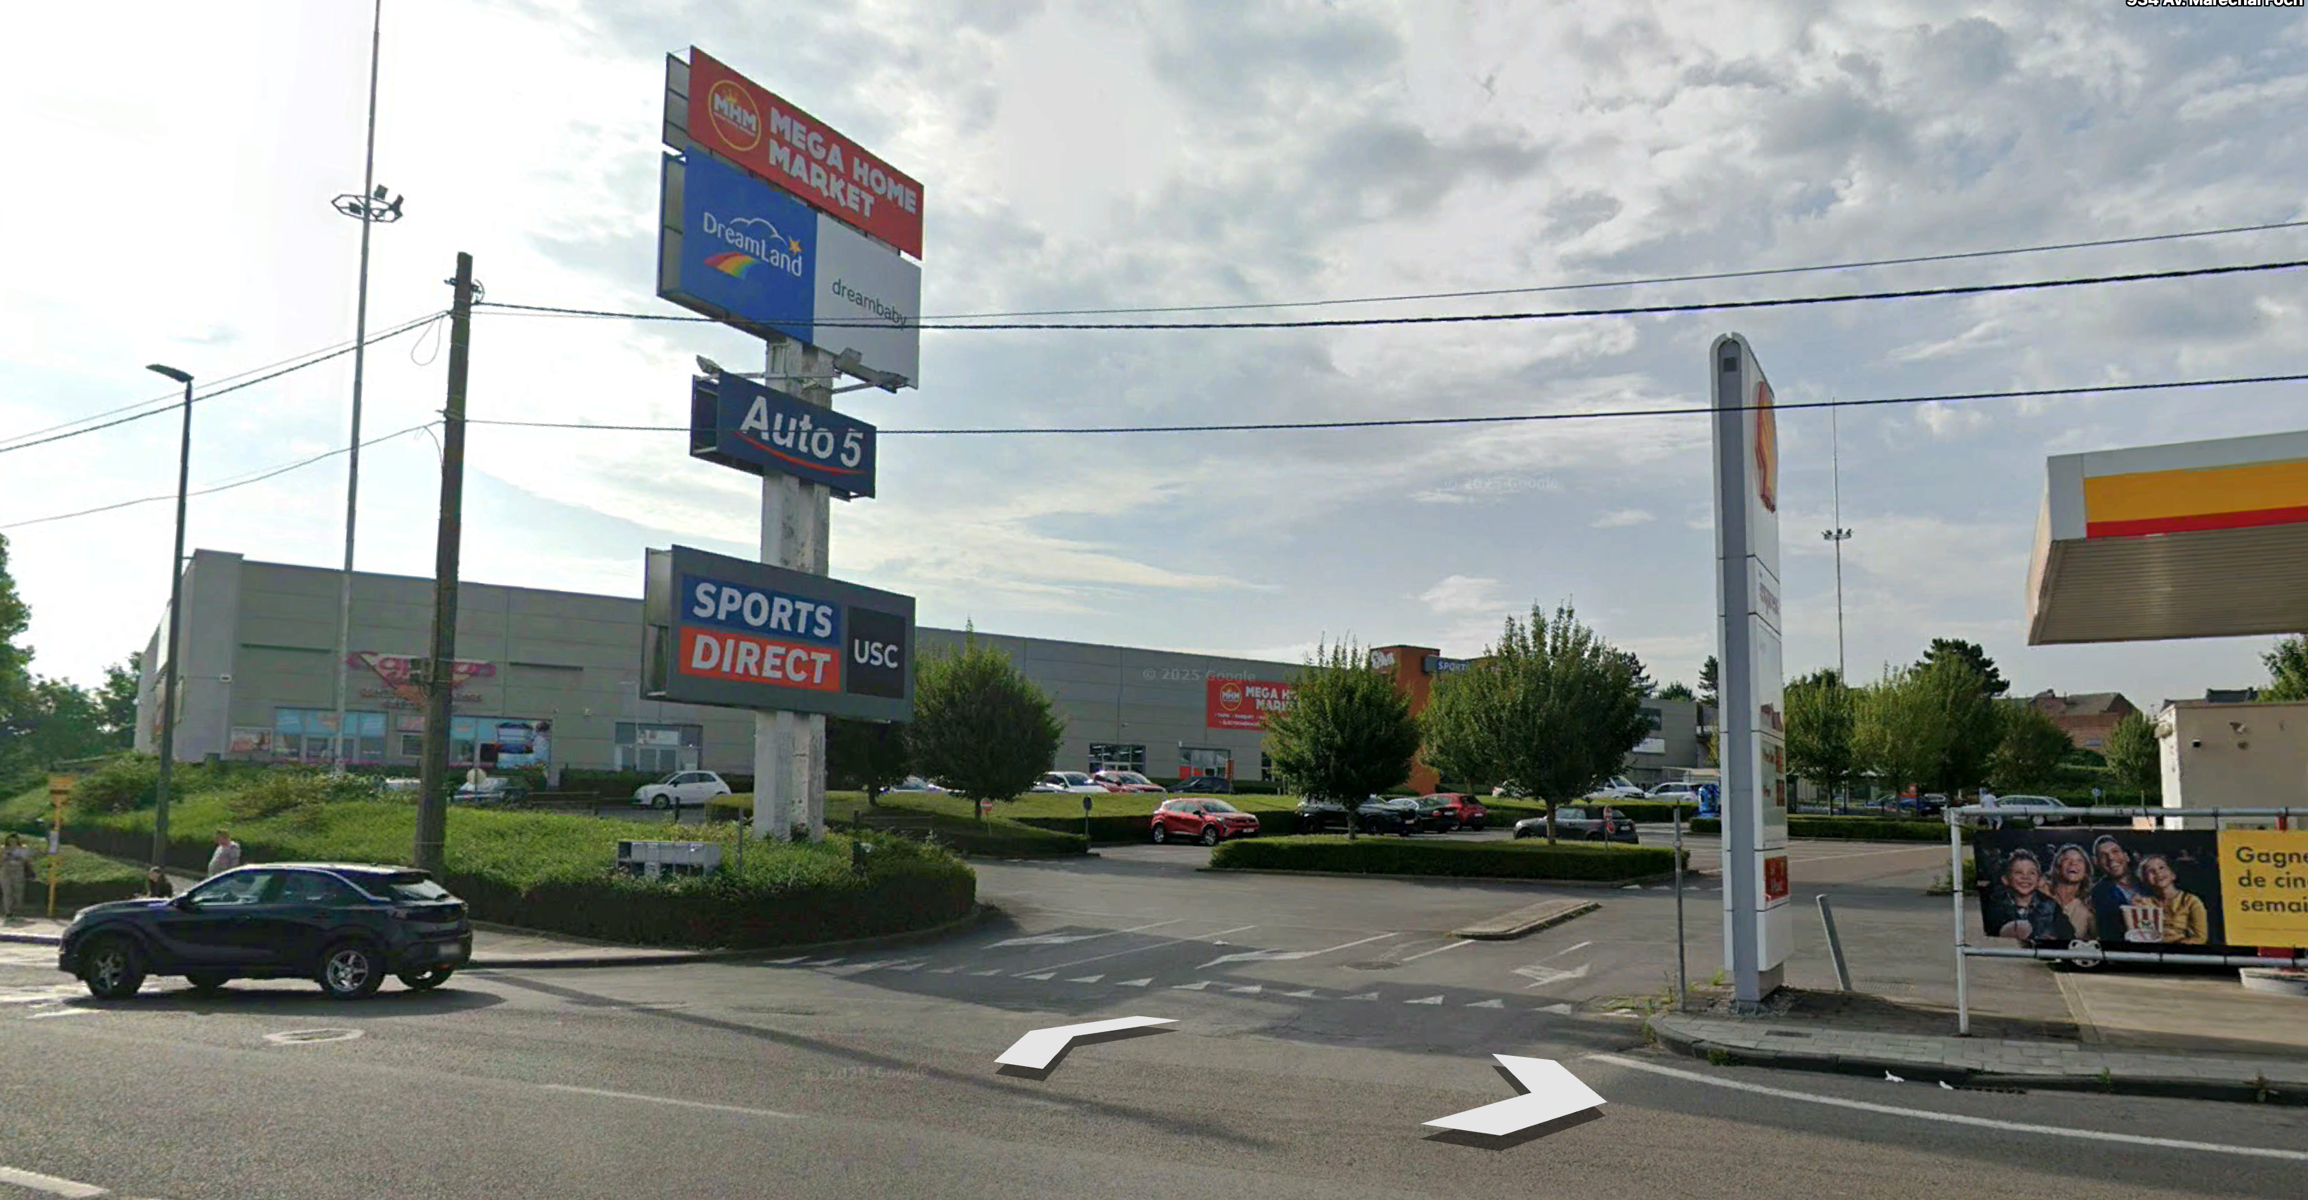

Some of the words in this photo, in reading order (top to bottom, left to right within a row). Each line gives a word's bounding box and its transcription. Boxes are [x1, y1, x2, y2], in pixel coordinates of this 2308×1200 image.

[713, 92, 757, 132] MHM
[769, 138, 875, 218] MARKET
[770, 107, 845, 174] MEGA
[853, 156, 917, 215] HOME
[703, 211, 803, 278] DreamLand
[832, 278, 907, 331] dreambaby
[740, 395, 834, 459] Auto
[840, 428, 864, 468] 5
[692, 582, 834, 638] SPORTS
[690, 634, 832, 685] DIRECT
[853, 638, 899, 669] USC
[1245, 685, 1278, 699] MEGA
[2238, 869, 2266, 888] de
